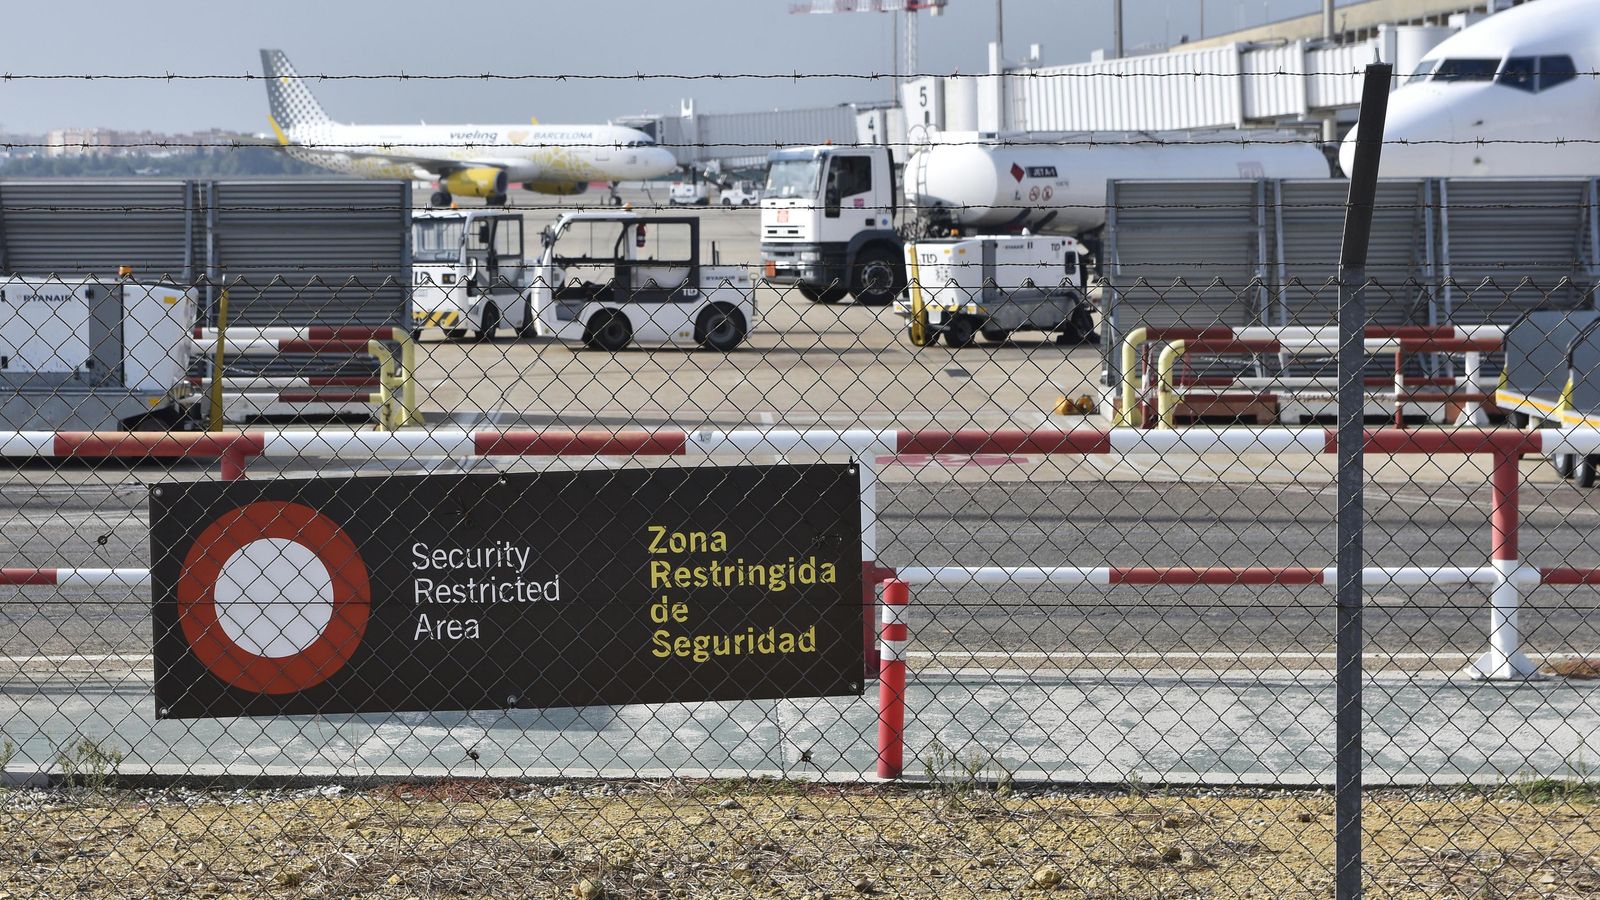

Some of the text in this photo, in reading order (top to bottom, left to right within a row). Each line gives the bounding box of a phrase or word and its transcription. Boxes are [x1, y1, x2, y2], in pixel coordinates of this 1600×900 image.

[919, 86, 928, 107] 5
[867, 116, 875, 130] 4
[450, 131, 498, 144] vueling
[533, 132, 593, 140] BARCELONA
[921, 253, 938, 263] TLD
[414, 271, 432, 286] LD
[23, 294, 72, 302] RYANAIR
[682, 288, 699, 297] TLD
[648, 525, 728, 554] Zona
[411, 541, 531, 574] Security
[650, 556, 837, 592] Restringida
[414, 574, 560, 605] Restricted
[650, 595, 689, 624] de
[413, 613, 480, 641] Area
[652, 625, 817, 663] Seguridad
